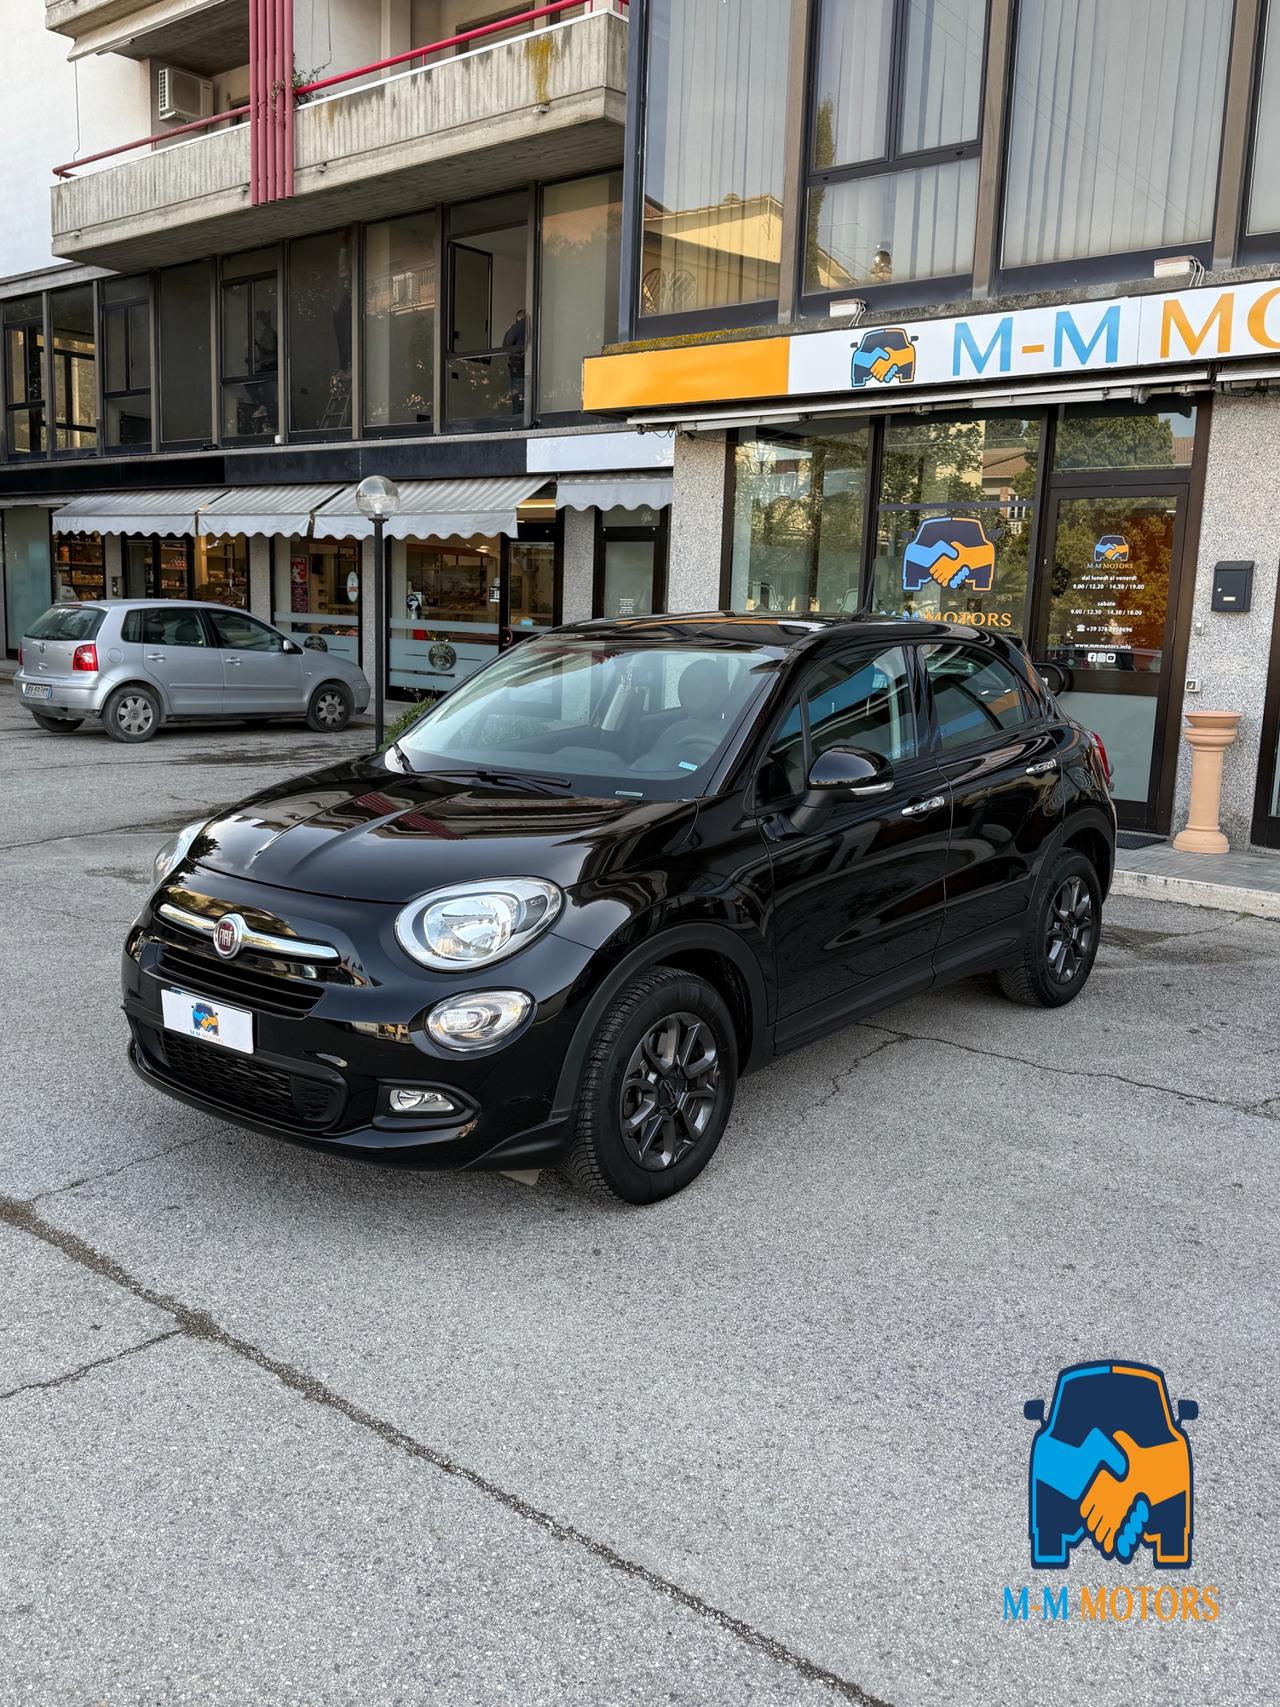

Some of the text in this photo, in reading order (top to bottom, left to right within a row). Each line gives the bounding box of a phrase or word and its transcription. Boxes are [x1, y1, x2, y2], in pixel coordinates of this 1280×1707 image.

[952, 305, 1121, 376] M-M
[925, 610, 1012, 627] MOTORS
[219, 928, 233, 947] FIAT
